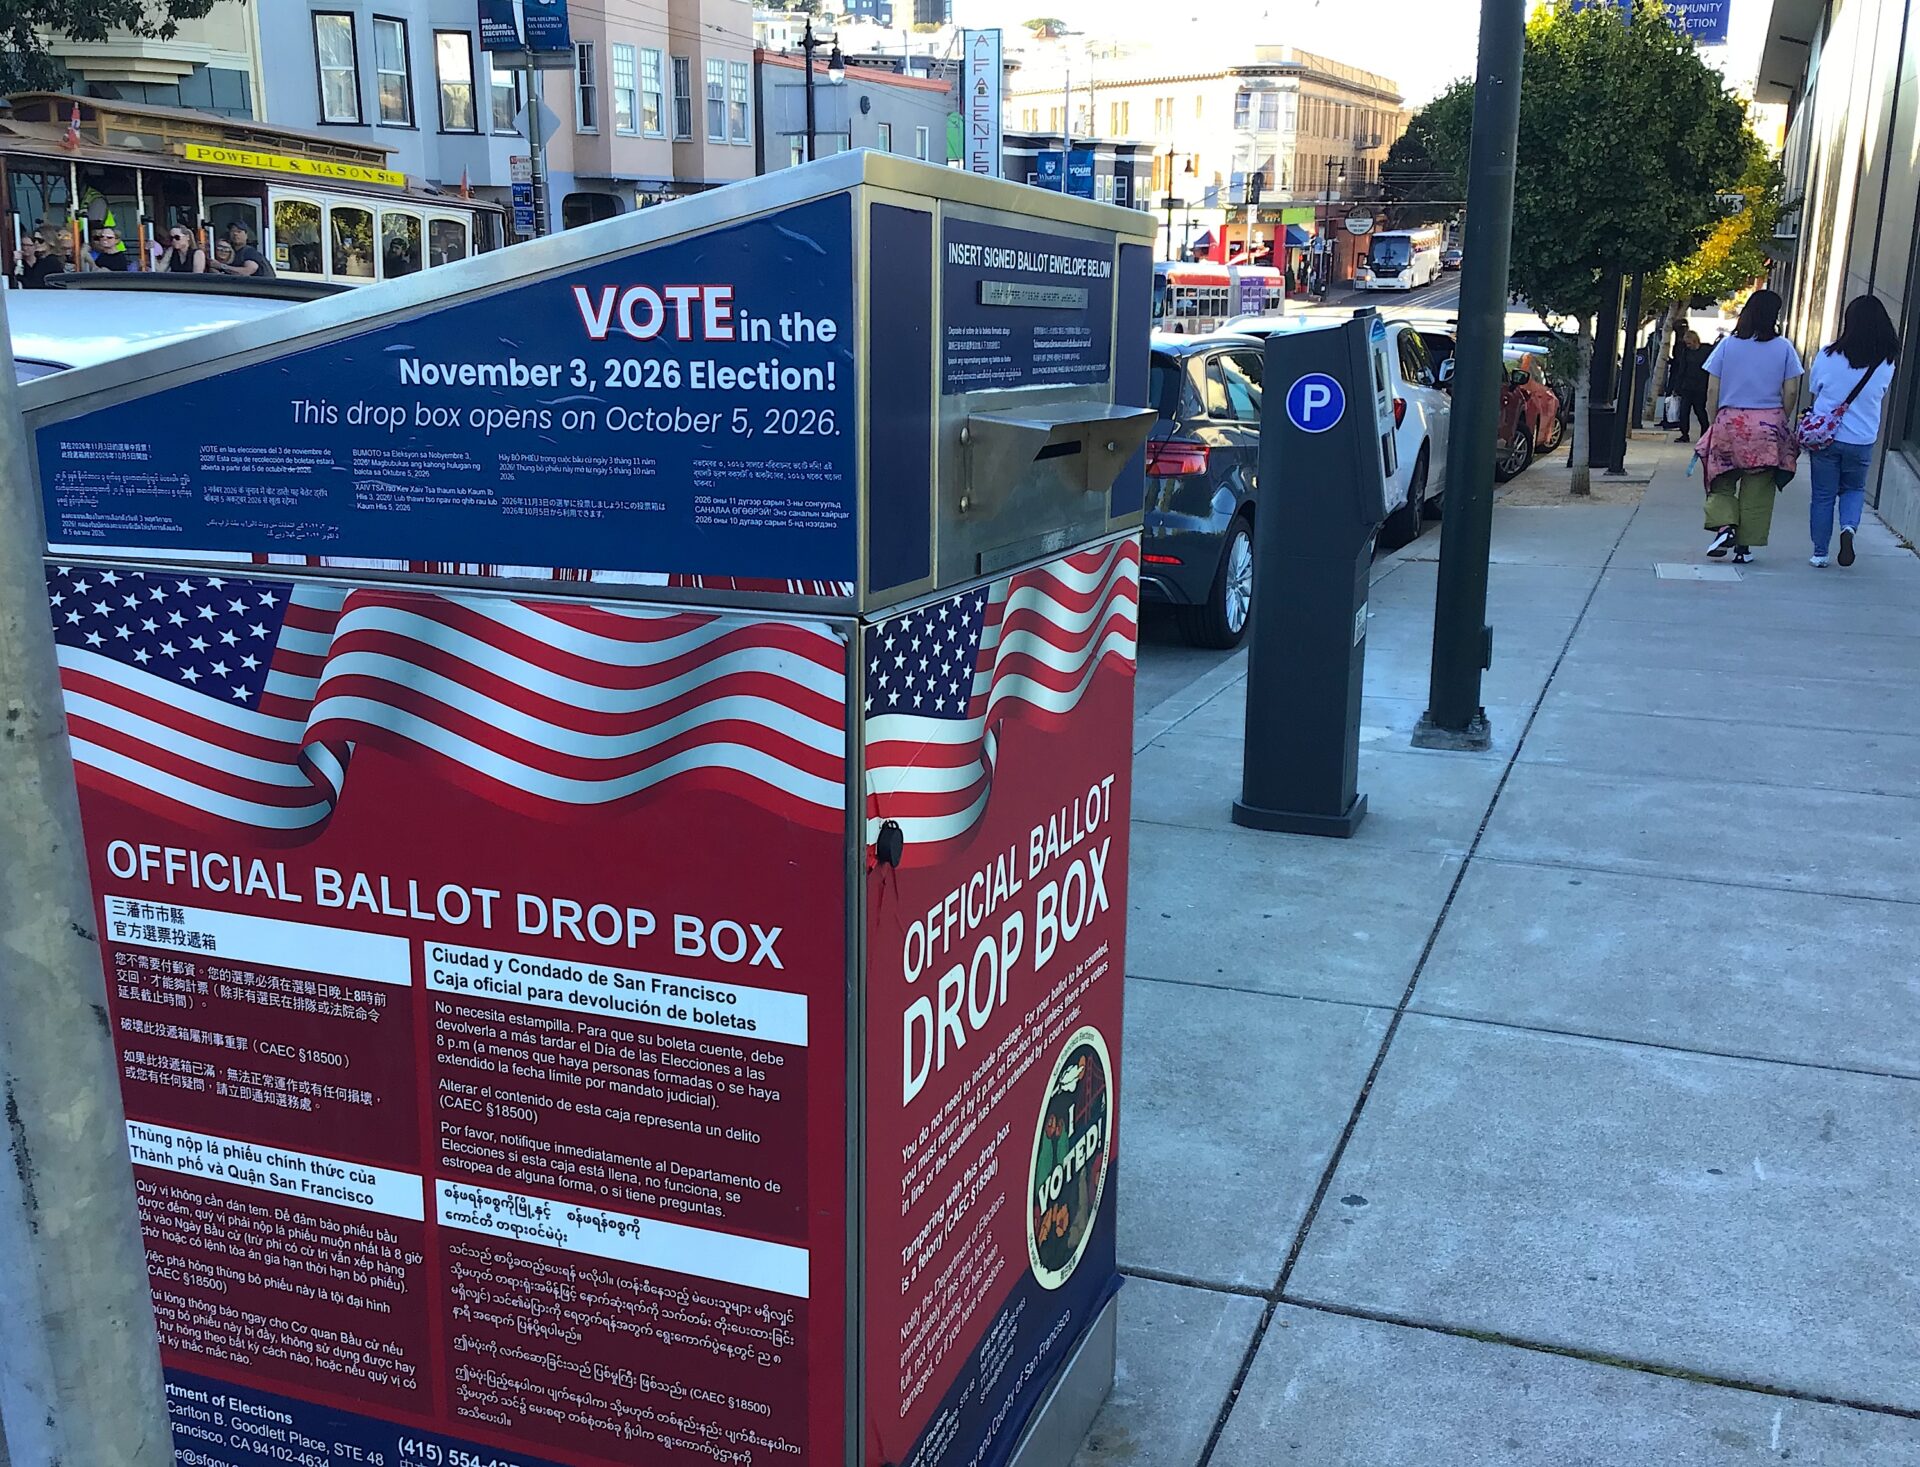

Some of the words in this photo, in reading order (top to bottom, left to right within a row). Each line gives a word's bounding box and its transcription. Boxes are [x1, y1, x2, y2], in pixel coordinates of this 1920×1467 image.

[1668, 3, 1722, 13] OMMUNITY
[197, 148, 281, 168] POWELL
[289, 161, 301, 171] &
[311, 162, 372, 179] MASON
[948, 242, 982, 266] INSERT
[984, 246, 1016, 269] SIGNED
[1017, 250, 1048, 272] BALLOT
[1049, 254, 1086, 276] ENVELOPE
[1087, 259, 1111, 278] BELOW
[573, 284, 735, 341] VOTE
[740, 309, 770, 341] in
[778, 311, 836, 343] the
[399, 357, 562, 387] November
[569, 358, 596, 392] 3,
[604, 358, 681, 388] 2026
[690, 359, 835, 391] Election!
[1303, 384, 1331, 422] P
[291, 399, 338, 424] This
[346, 400, 406, 433] drop
[415, 401, 461, 427] box
[469, 404, 552, 434] opens
[561, 410, 595, 430] on
[606, 406, 722, 433] October
[731, 407, 753, 438] 5,
[763, 408, 840, 435] 2026.
[107, 840, 302, 902] OFFICIAL
[314, 866, 500, 929] BALLOT
[516, 893, 656, 948] DROP
[674, 913, 783, 969] BOX
[903, 844, 1022, 983] OFFICIAL
[1028, 774, 1115, 880] BALLOT
[112, 899, 185, 925] 三藩市市縣
[114, 921, 217, 951] 官方選票投遞箱
[432, 947, 488, 969] Ciudad
[493, 959, 503, 974] y
[508, 957, 582, 982] Condado
[588, 969, 608, 986] de
[613, 972, 645, 991] San
[651, 977, 736, 1005] Francisco
[433, 969, 468, 990] Caja
[473, 976, 522, 996] oficial
[527, 986, 563, 1002] para
[568, 990, 661, 1017] devolución
[666, 1005, 687, 1021] de
[693, 1008, 756, 1031] boletas
[903, 910, 1024, 1107] DROP
[1034, 836, 1111, 973] BOX
[435, 1000, 452, 1014] No
[455, 1006, 505, 1022] necesita
[508, 1014, 574, 1033] estampilla.
[577, 1022, 606, 1038] Para
[610, 1030, 634, 1043] que
[637, 1034, 652, 1045] su
[656, 1034, 695, 1052] boleta
[699, 1044, 746, 1062] cuente,
[750, 1049, 784, 1066] debe
[438, 1078, 478, 1095] Alterar
[480, 1085, 491, 1098] el
[494, 1089, 553, 1108] contenido
[556, 1097, 572, 1111] de
[575, 1103, 601, 1116] esta
[604, 1107, 630, 1123] caja
[634, 1113, 702, 1133] representa
[705, 1125, 721, 1137] un
[725, 1126, 760, 1143] delito
[439, 1094, 482, 1112] (CAEC
[486, 1102, 538, 1125] §18500)
[1067, 1103, 1075, 1138] I
[128, 1124, 172, 1149] Thùng
[176, 1136, 202, 1156] nộp
[206, 1139, 218, 1155] lá
[222, 1144, 262, 1163] phiếu
[266, 1153, 306, 1172] chính
[310, 1160, 345, 1179] thức
[349, 1169, 376, 1185] của
[130, 1144, 173, 1165] Thành
[177, 1155, 203, 1171] phố
[207, 1161, 224, 1175] và
[227, 1164, 265, 1185] Quận
[269, 1172, 296, 1190] San
[301, 1178, 374, 1205] Francisco
[1038, 1118, 1103, 1216] VOTED!
[442, 1156, 493, 1174] estropea
[496, 1164, 511, 1177] de
[514, 1168, 555, 1185] alguna
[558, 1174, 596, 1194] forma,
[600, 1185, 608, 1195] o
[611, 1185, 622, 1198] si
[625, 1187, 656, 1204] tiene
[659, 1196, 725, 1217] preguntas.
[901, 1204, 945, 1266] Tampering
[946, 1181, 963, 1207] with
[963, 1163, 978, 1188] this
[978, 1141, 996, 1168] drop
[997, 1122, 1011, 1146] box
[901, 1278, 909, 1294] is
[911, 1266, 917, 1281] a
[918, 1230, 943, 1272] felony
[944, 1194, 970, 1240] (CAEC
[970, 1157, 999, 1205] §18500)
[165, 1383, 209, 1404] rtment
[211, 1393, 225, 1408] of
[229, 1397, 293, 1425] Elections
[978, 1427, 992, 1460] and
[992, 1389, 1015, 1434] County
[1015, 1371, 1024, 1394] of
[1024, 1355, 1038, 1381] San
[1039, 1309, 1071, 1361] Francisco
[167, 1400, 211, 1423] Carlton
[214, 1412, 228, 1428] B.
[231, 1416, 286, 1442] Goodlett
[289, 1430, 331, 1455] Place,
[334, 1442, 364, 1462] STE
[367, 1451, 385, 1467] 48
[398, 1436, 444, 1466] (415)
